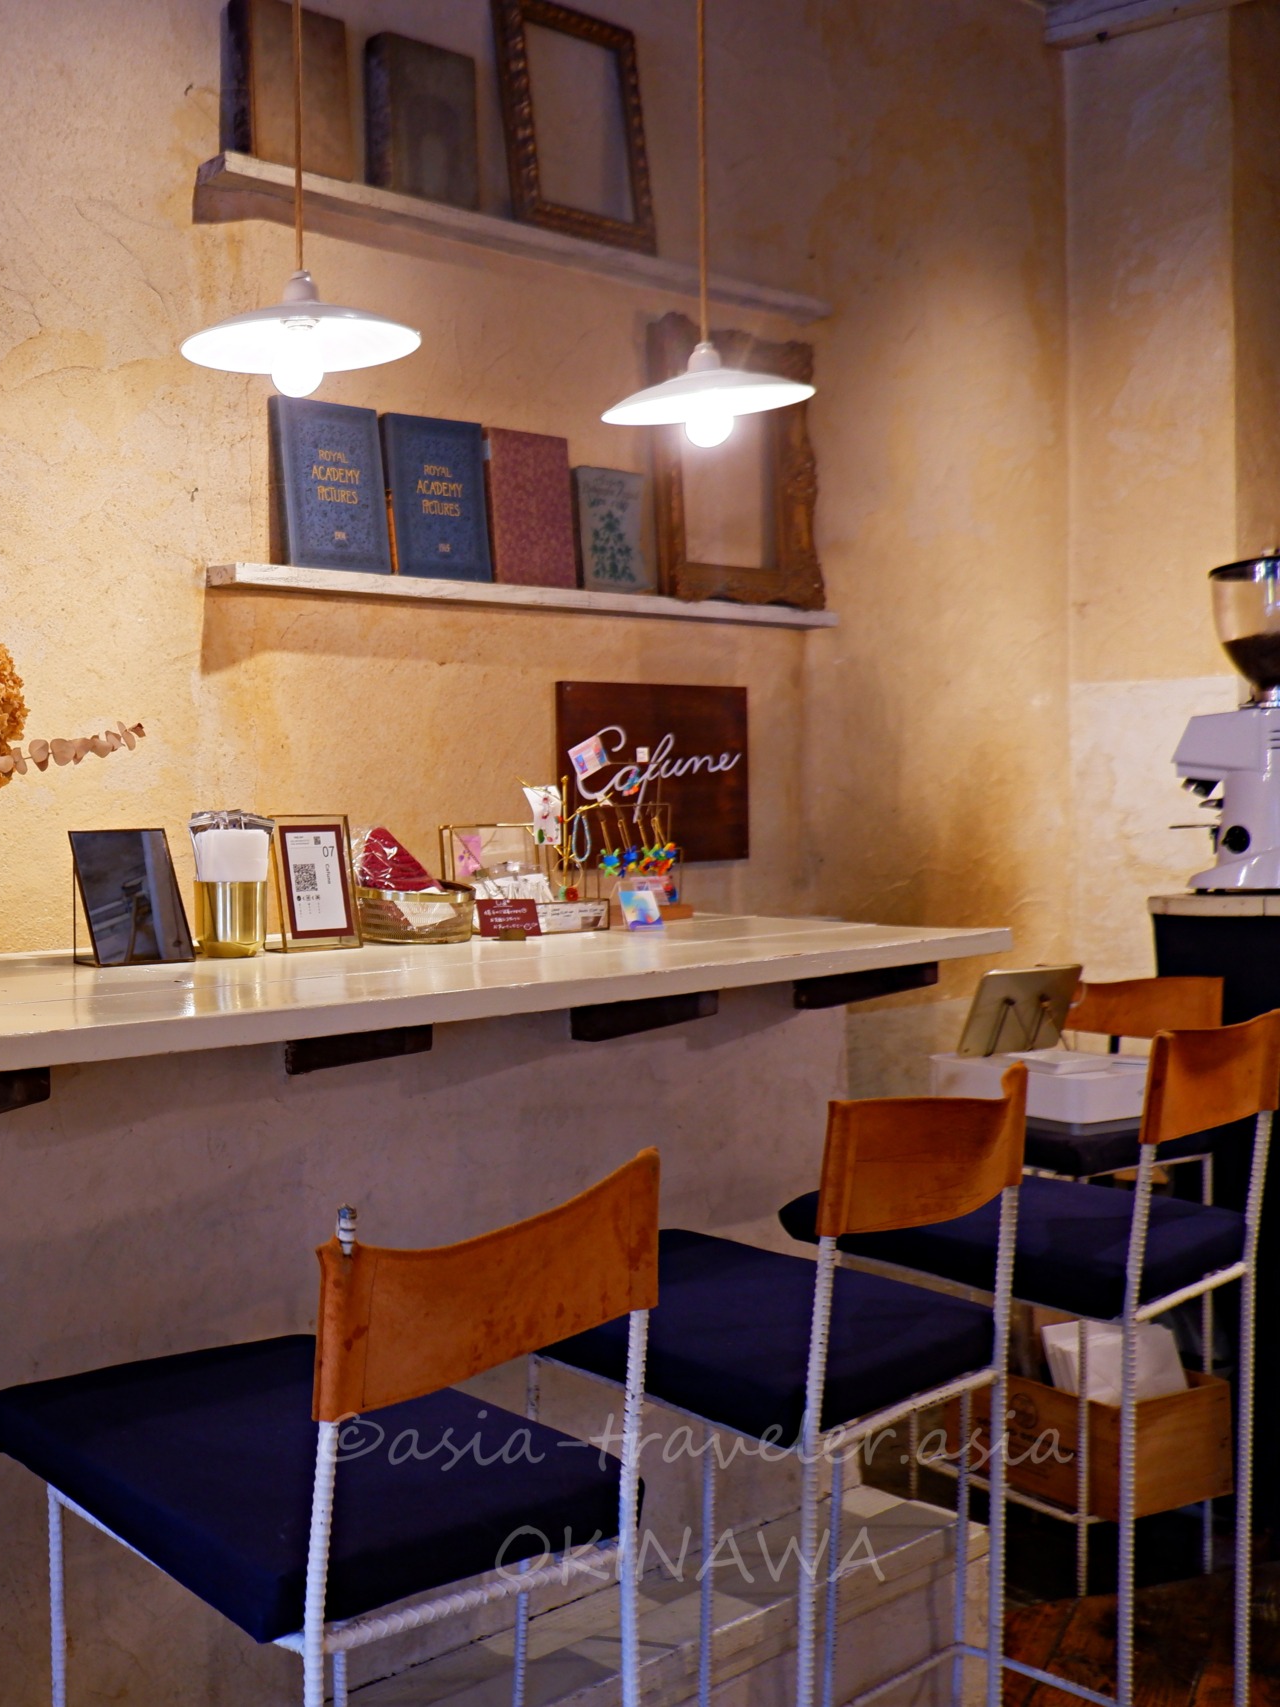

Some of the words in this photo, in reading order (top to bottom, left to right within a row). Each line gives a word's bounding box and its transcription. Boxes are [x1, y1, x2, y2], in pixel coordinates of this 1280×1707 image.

[318, 449, 349, 464] ROYAL
[312, 465, 360, 485] ACADEMY
[423, 465, 453, 478] ROYAL
[317, 485, 359, 505] PICTURES
[416, 480, 463, 498] ACADEMY
[422, 499, 461, 517] PICTURES
[576, 726, 742, 824] Cafune
[322, 845, 335, 858] 07
